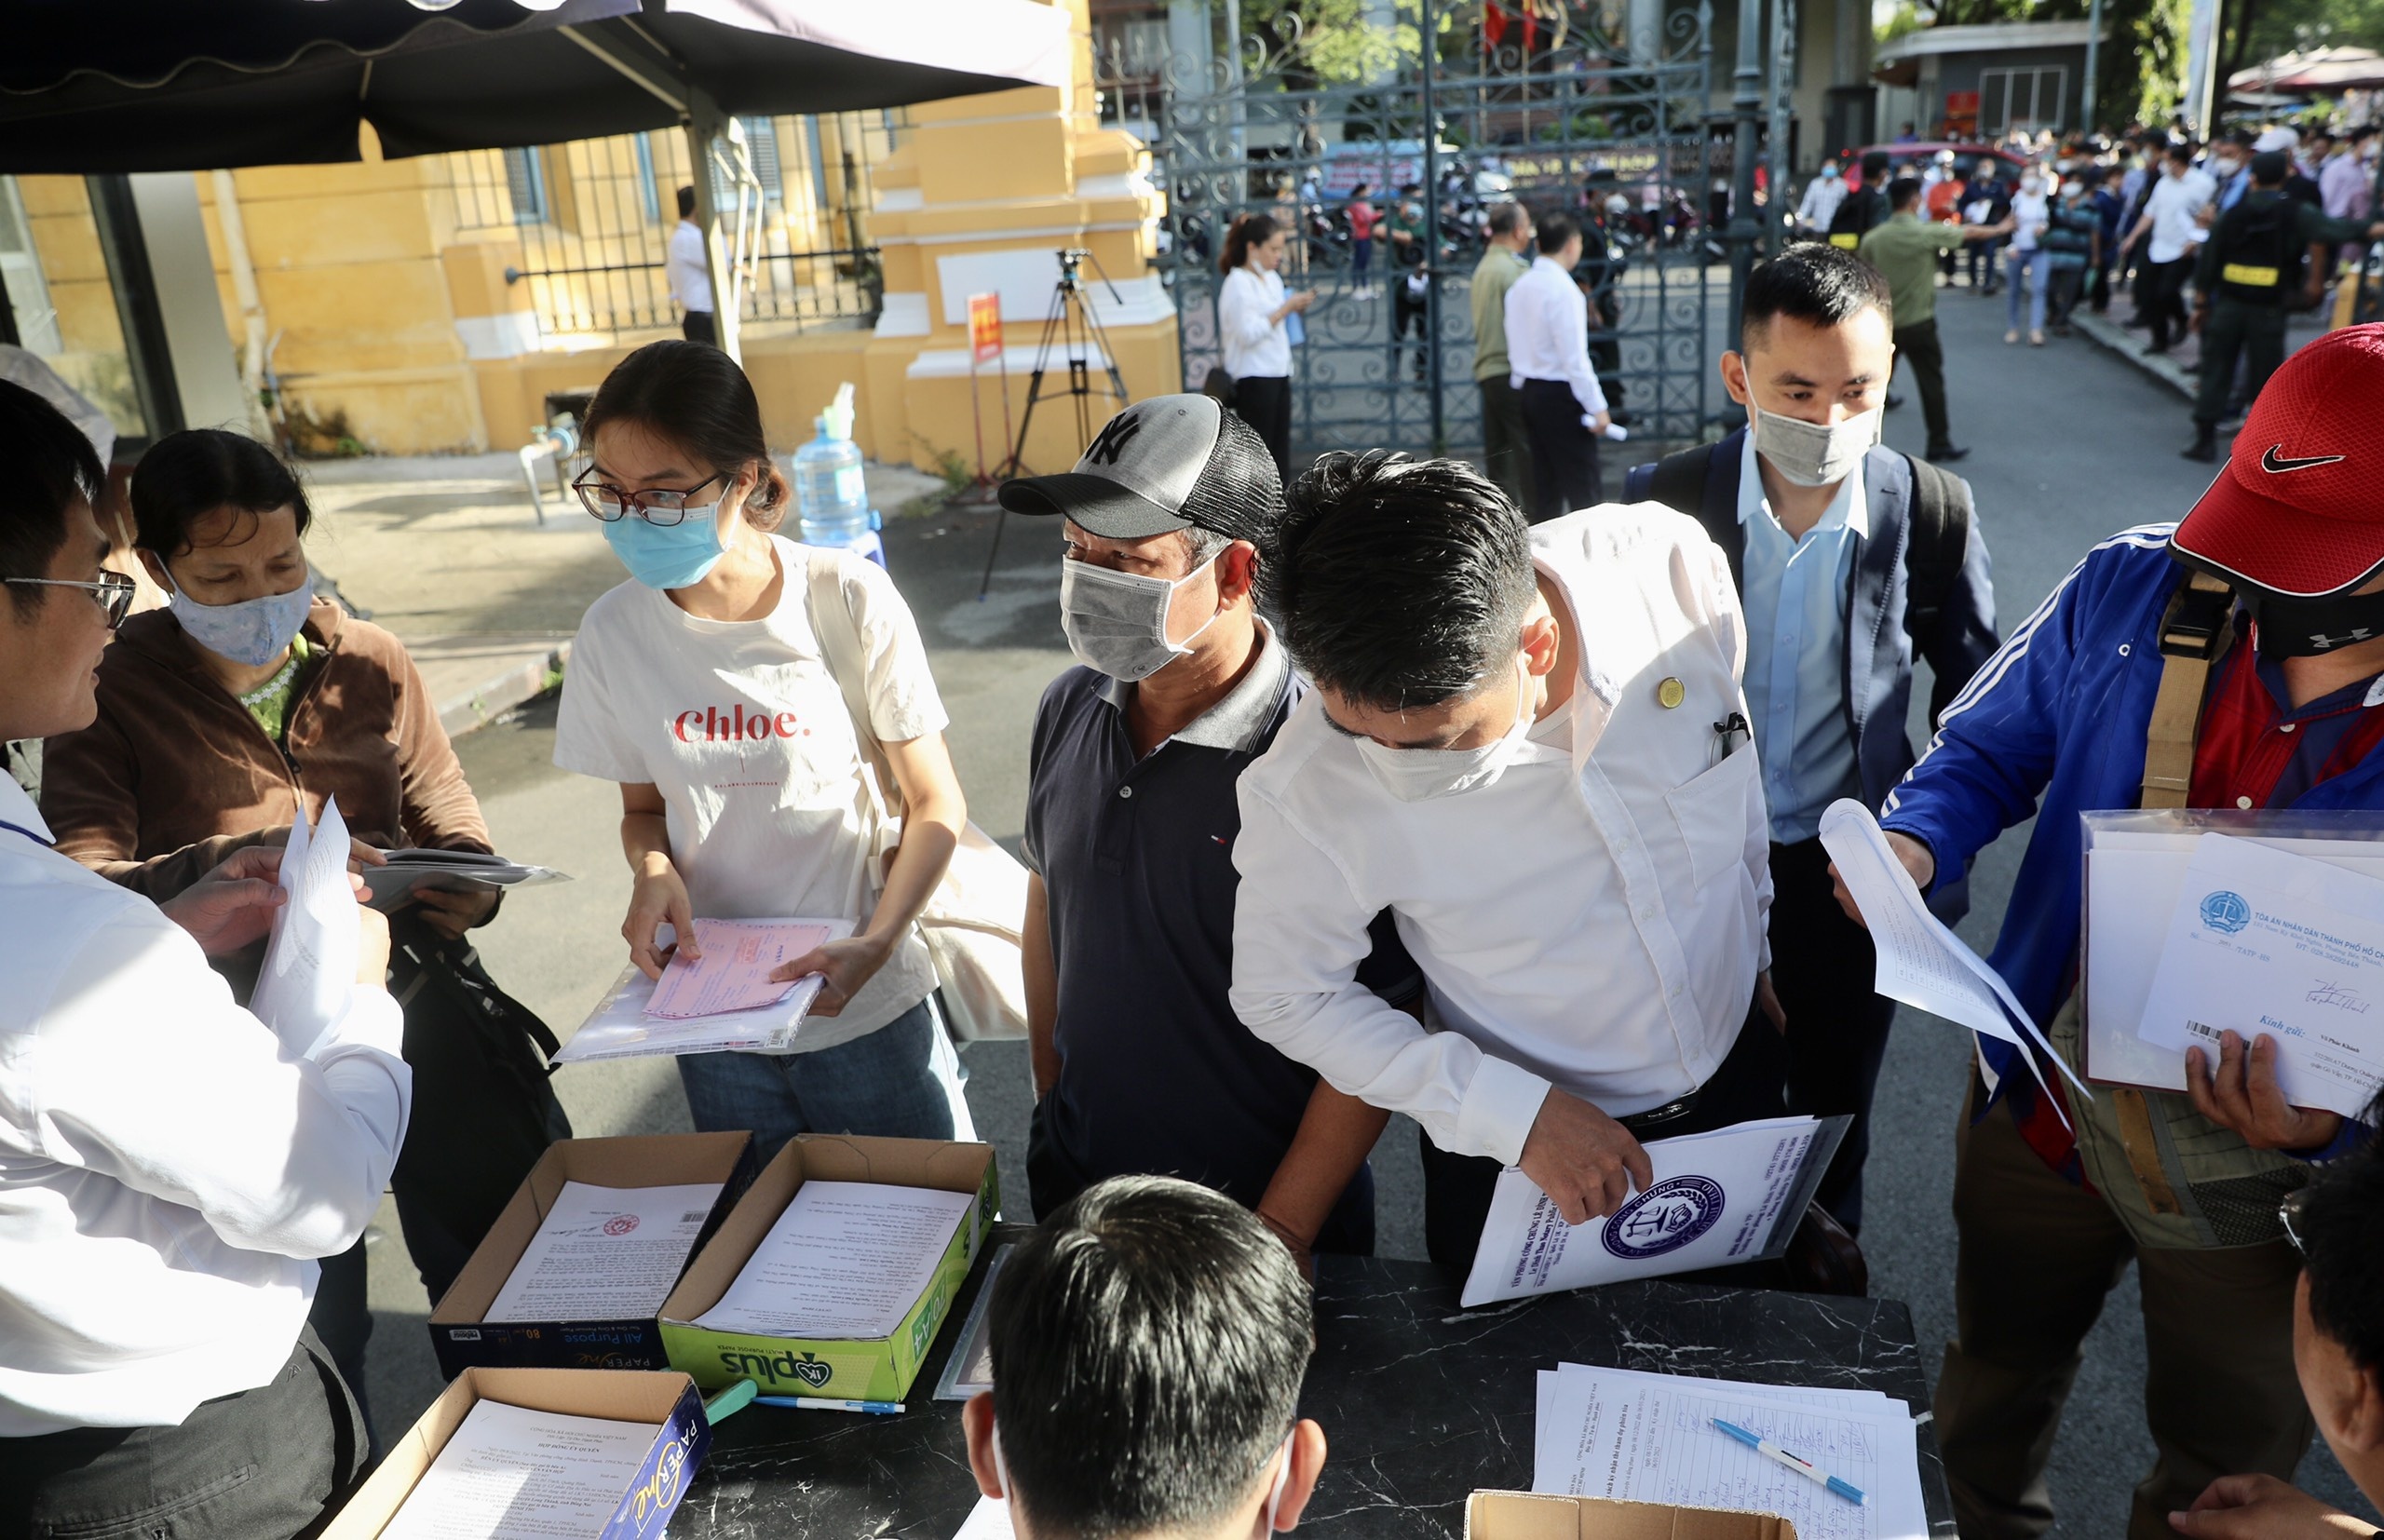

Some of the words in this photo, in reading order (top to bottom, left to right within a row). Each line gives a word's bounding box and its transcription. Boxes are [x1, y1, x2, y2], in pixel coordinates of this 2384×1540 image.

[673, 704, 811, 744] Chloe.
[2254, 911, 2270, 922] TÒA
[2270, 917, 2281, 926] ÁN
[2282, 920, 2303, 933] NHÂN
[2303, 927, 2319, 938] DÂN
[2319, 932, 2344, 946] THÀNH
[2344, 939, 2362, 952] PHỐ
[2362, 945, 2374, 956] HỒ
[2259, 1014, 2285, 1030] Kính
[2284, 1023, 2307, 1040] gửi:
[1635, 1182, 1675, 1208] CHỨNG
[1545, 1207, 1558, 1223] Public
[1525, 1221, 1541, 1239] CHỨNG
[1539, 1225, 1553, 1241] Notary
[1520, 1241, 1534, 1255] CÔNG
[1514, 1258, 1529, 1275] PHÒNG
[526, 1329, 541, 1339] 80
[564, 1332, 620, 1344] Purpose
[624, 1333, 641, 1343] All
[606, 1358, 650, 1367] PAPER
[720, 1351, 799, 1385] plus
[1618, 1413, 1629, 1428] phiên
[1616, 1428, 1626, 1436] dự
[1614, 1436, 1623, 1450] tham
[579, 1446, 600, 1455] QUYỀN
[661, 1418, 698, 1485] PAPER
[1612, 1450, 1620, 1459] thẻ
[1609, 1460, 1619, 1474] nhận
[1604, 1482, 1613, 1494] sách
